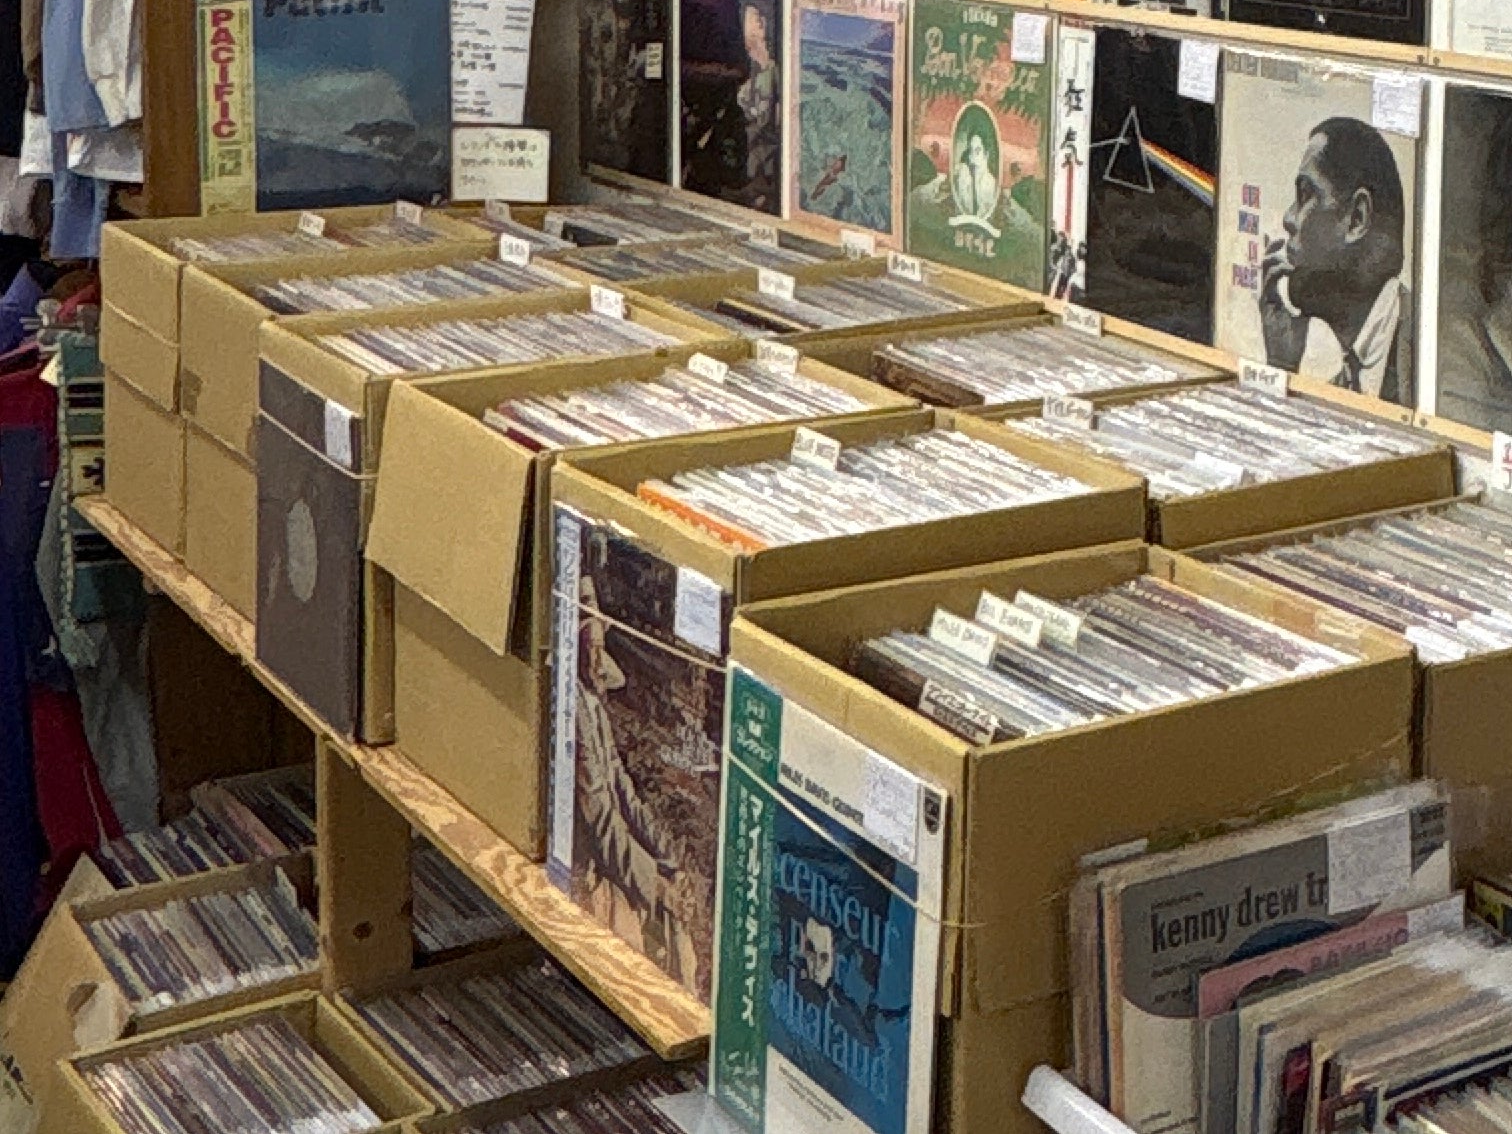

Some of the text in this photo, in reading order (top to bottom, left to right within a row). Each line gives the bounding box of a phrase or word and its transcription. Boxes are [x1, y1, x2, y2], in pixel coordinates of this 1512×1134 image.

[211, 9, 238, 139] PACIFIC
[1149, 895, 1232, 954] kenny
[1237, 876, 1303, 927] drew
